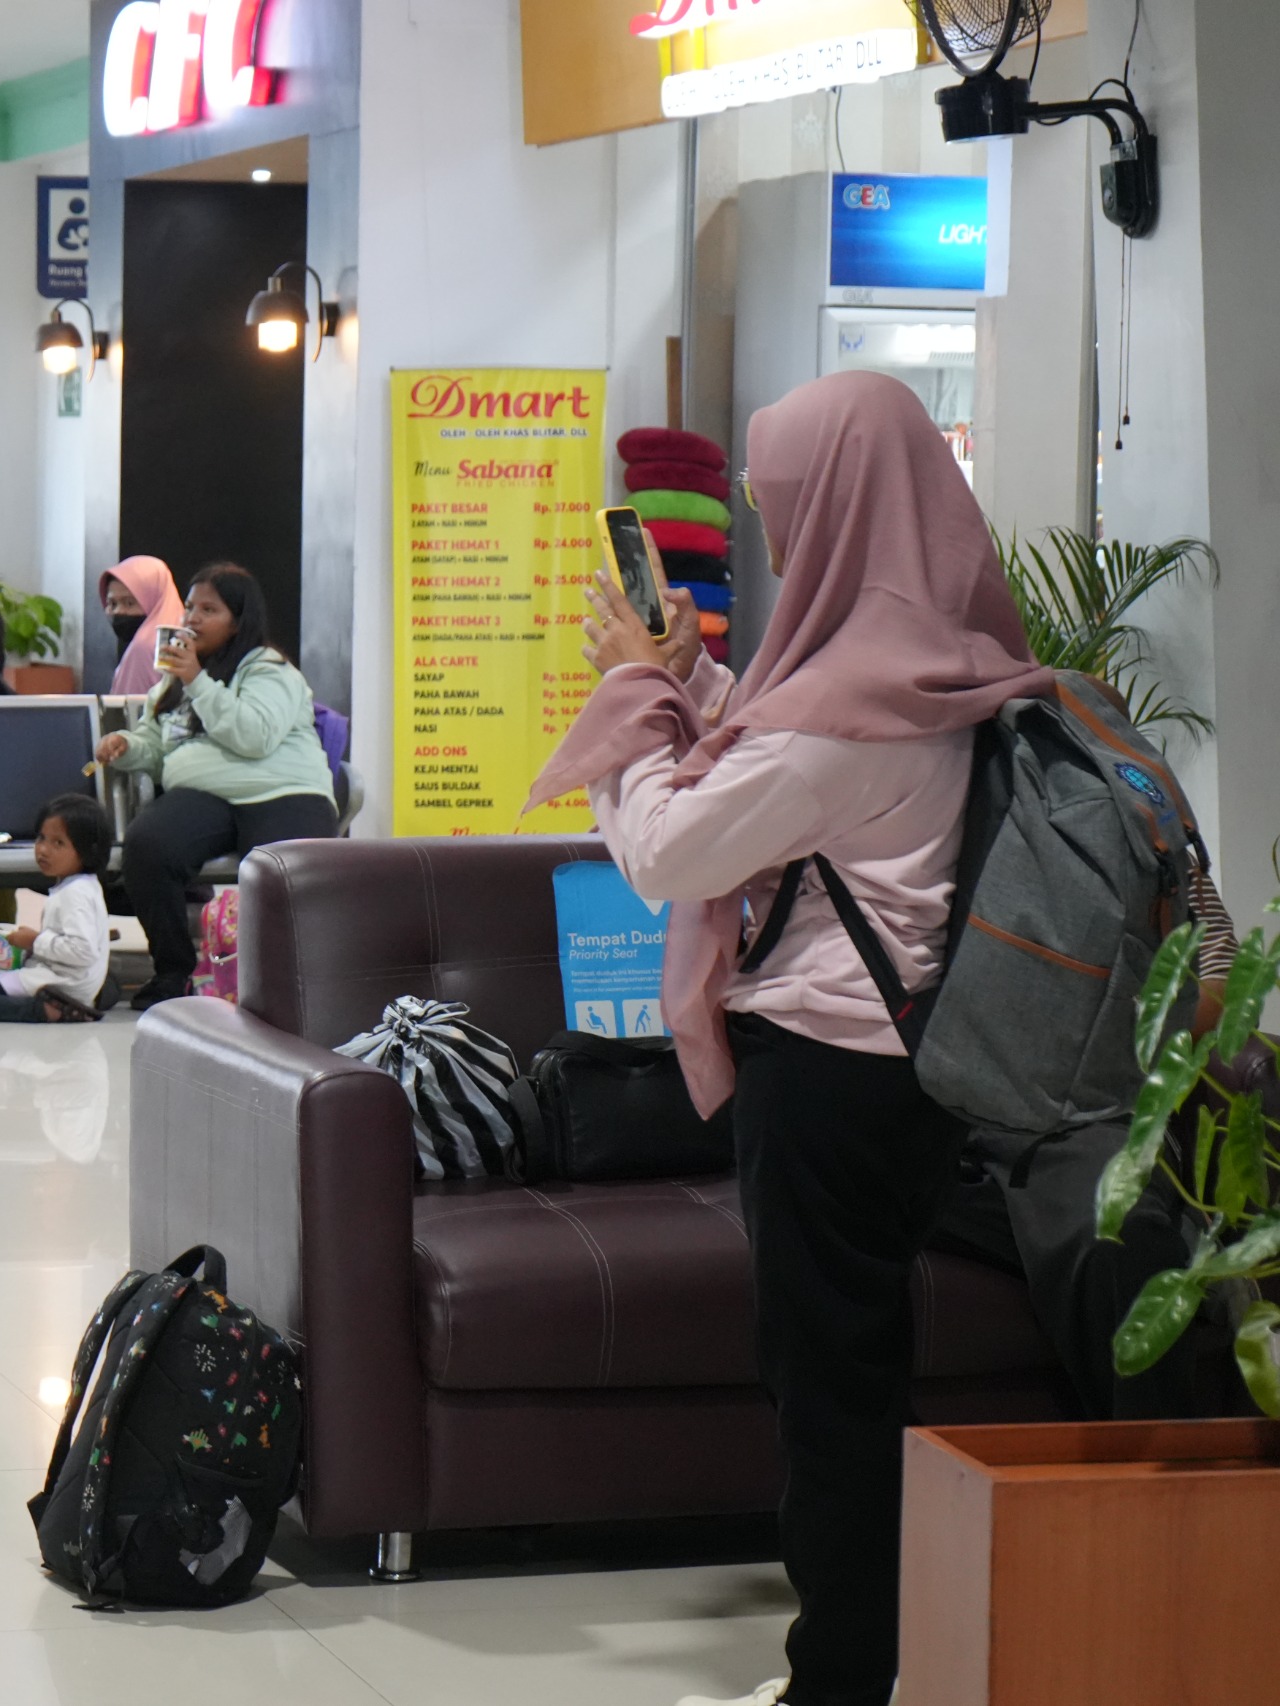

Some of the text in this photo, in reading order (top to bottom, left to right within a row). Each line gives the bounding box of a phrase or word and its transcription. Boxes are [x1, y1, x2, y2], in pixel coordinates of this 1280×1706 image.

[856, 37, 882, 70] DLL
[103, 0, 268, 136] CFC
[842, 182, 891, 210] GEA
[407, 375, 590, 420] Dmart
[475, 429, 500, 438] OLEH
[503, 428, 529, 438] KHAS
[413, 458, 554, 480] Menu Sabana
[411, 503, 448, 514] PAKET
[451, 503, 488, 514] BESAR
[533, 502, 552, 515] Rp.
[411, 539, 448, 551] PAKET
[451, 539, 491, 551] HEMAT
[533, 538, 552, 552] Rp.
[411, 576, 448, 588] PAKET
[451, 576, 491, 588] HEMAT
[494, 576, 501, 587] 2
[534, 575, 552, 588] Rp.
[412, 613, 591, 627] PAKET HEMAT 3 Rp. 27.00
[413, 656, 479, 668] ALA CARTE
[413, 673, 445, 682] SAYAP
[413, 690, 441, 699] PAHA
[443, 690, 479, 699] BAWAH
[413, 707, 441, 716] PAHA
[443, 707, 468, 716] ATAS
[476, 707, 504, 716] DADA
[413, 724, 437, 733] NASI
[414, 746, 468, 757] ADD ONS
[414, 764, 479, 774] KEJU MENTAI
[414, 782, 481, 791] SAUS BULDAK
[414, 798, 453, 808] SAMBEL
[455, 798, 494, 808] GEPREK
[567, 931, 627, 949] Tempat
[569, 947, 638, 961] Priority Seat
